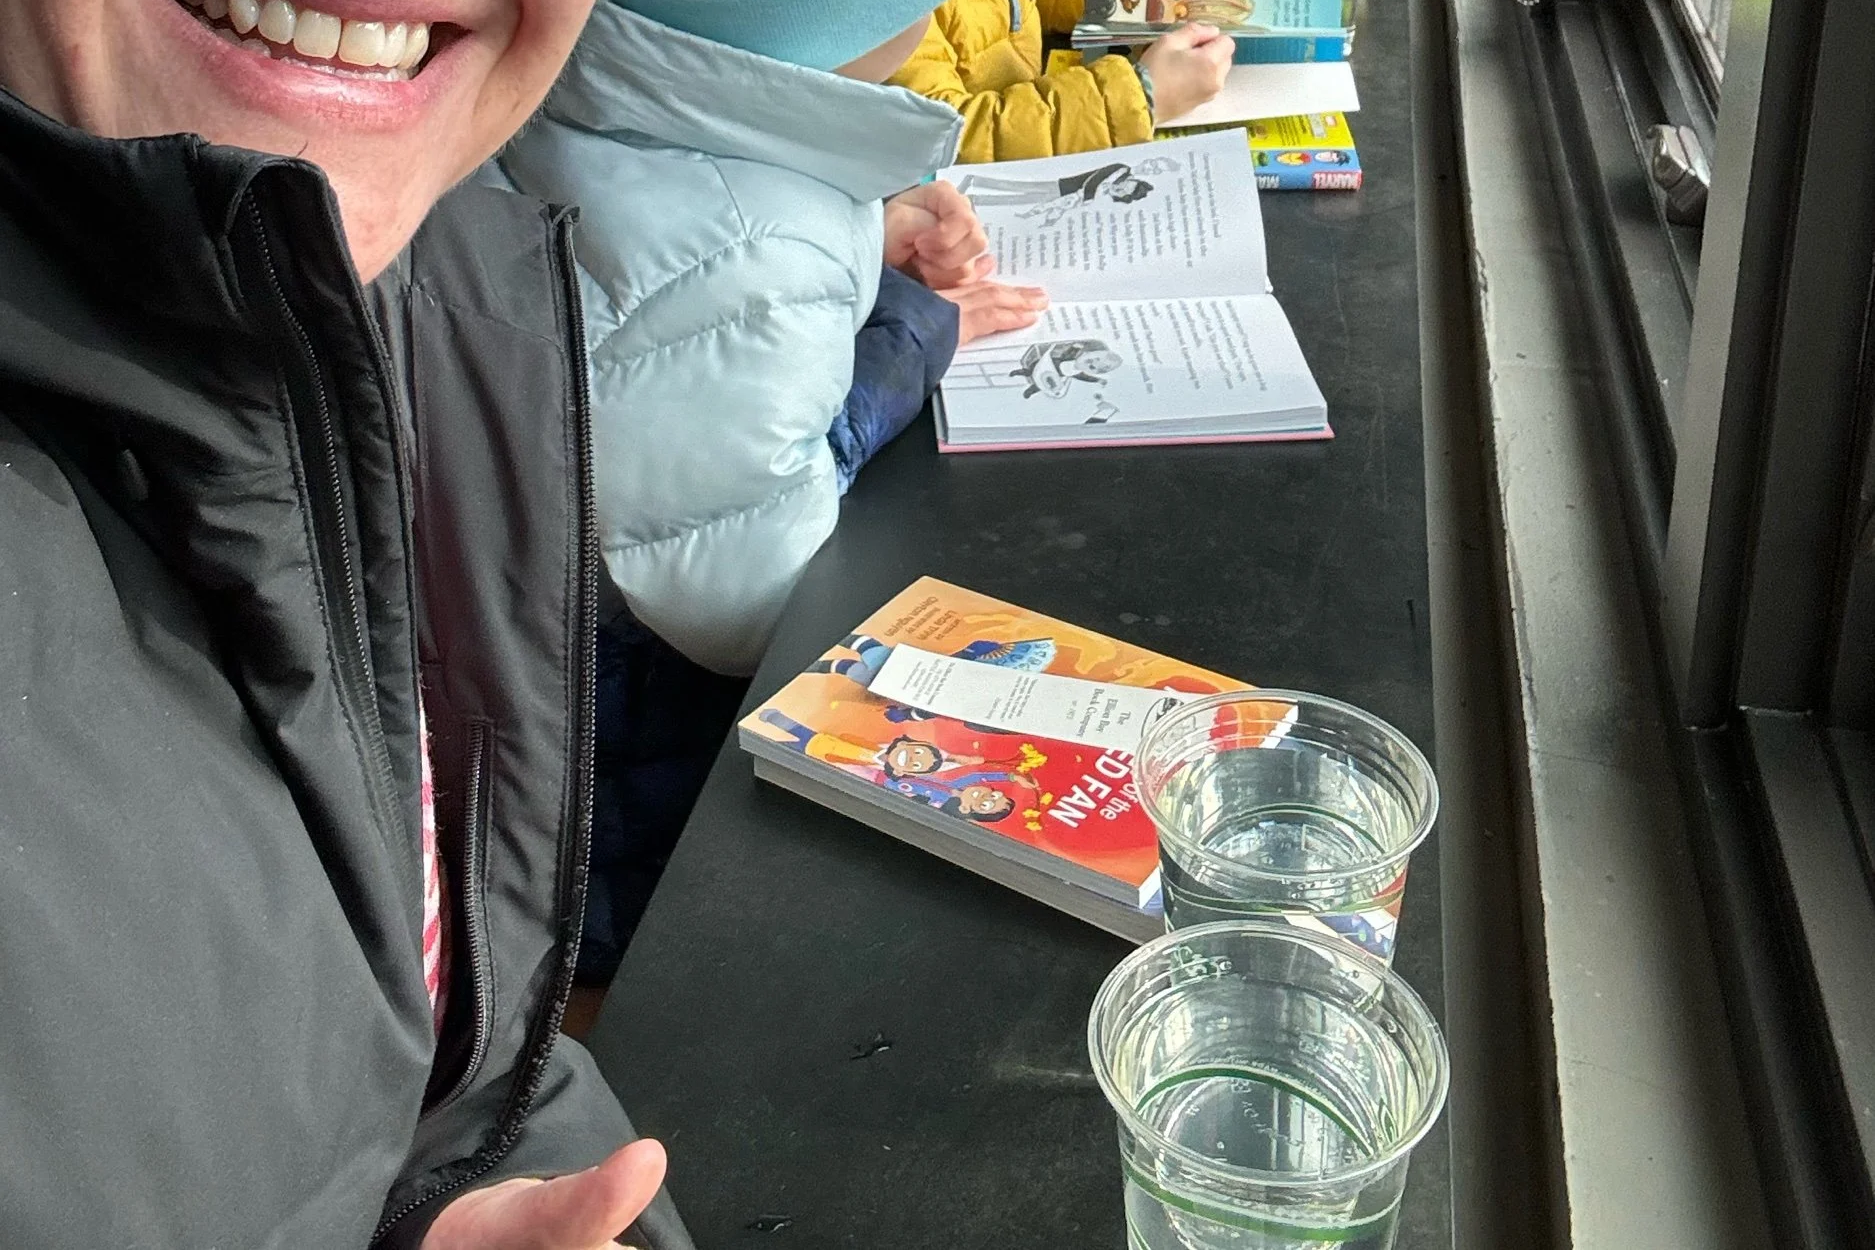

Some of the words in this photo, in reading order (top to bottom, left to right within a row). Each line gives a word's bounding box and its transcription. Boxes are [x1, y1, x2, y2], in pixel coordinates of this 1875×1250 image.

[1313, 172, 1361, 190] MARVEL
[1117, 710, 1131, 725] The
[1047, 774, 1112, 828] FAN
[1118, 782, 1139, 803] of
[1099, 797, 1132, 820] the
